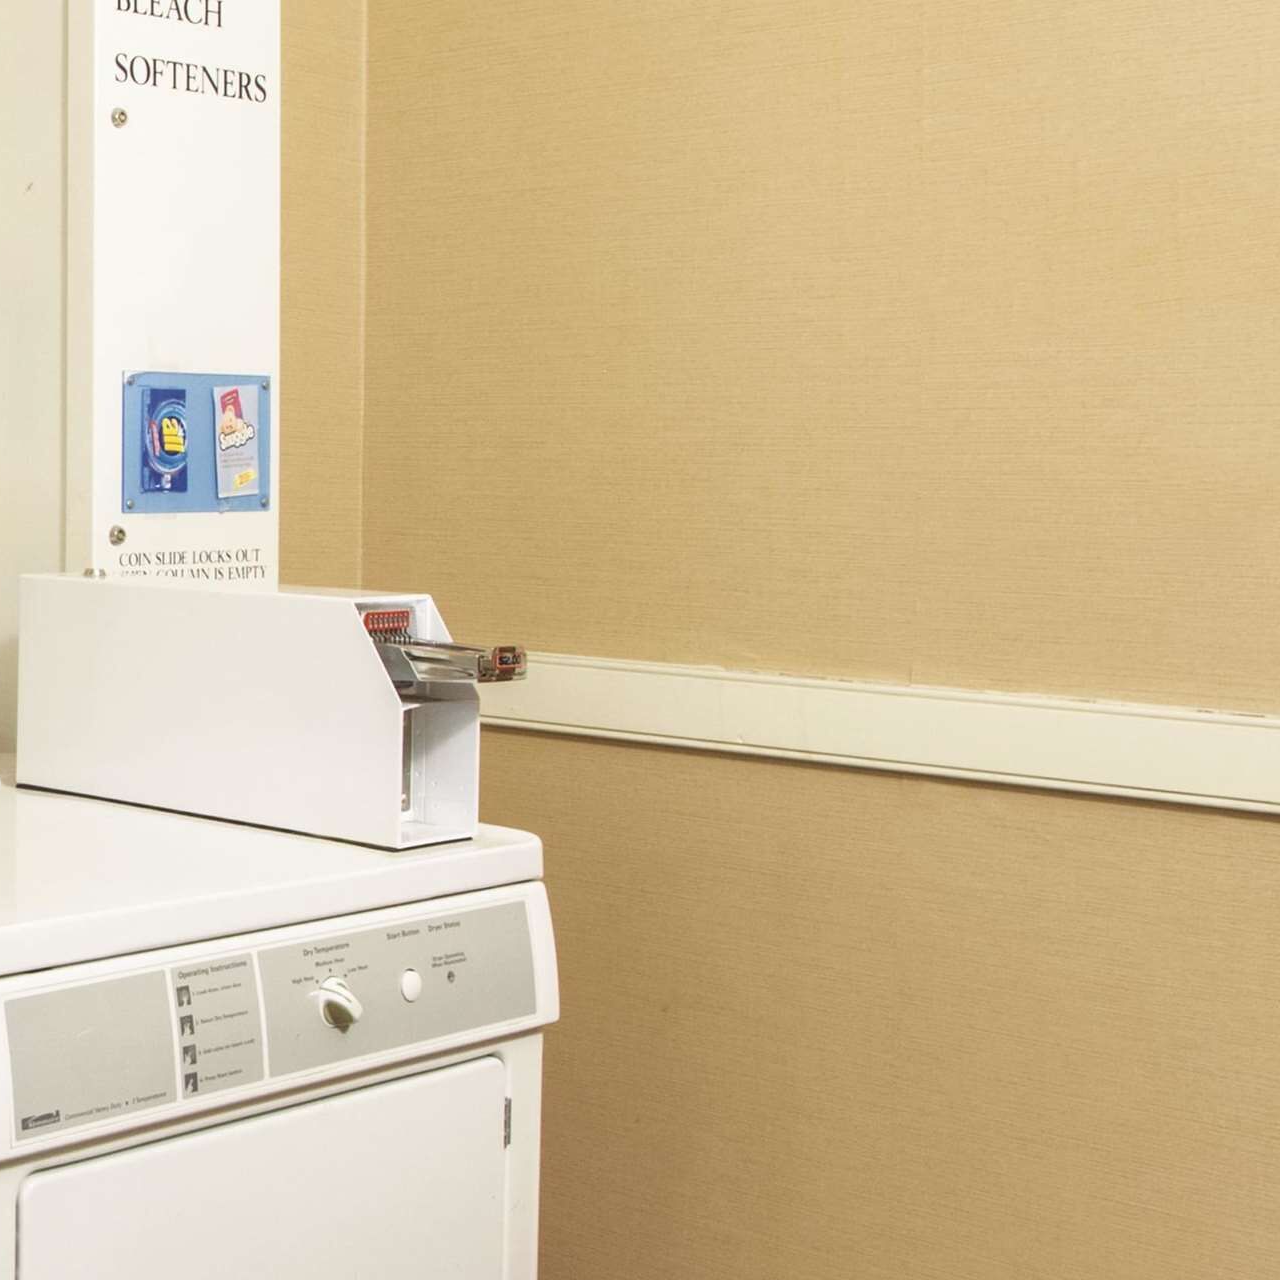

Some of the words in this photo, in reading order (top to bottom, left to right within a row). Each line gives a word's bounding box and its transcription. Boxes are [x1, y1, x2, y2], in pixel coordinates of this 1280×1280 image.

[115, 53, 267, 103] SOFTENERS
[119, 552, 152, 567] COIN
[155, 550, 187, 566] SLIDE
[192, 549, 232, 565] LOCKS
[235, 548, 261, 563] OUT
[214, 567, 224, 580] IS
[228, 565, 266, 580] EMPTY
